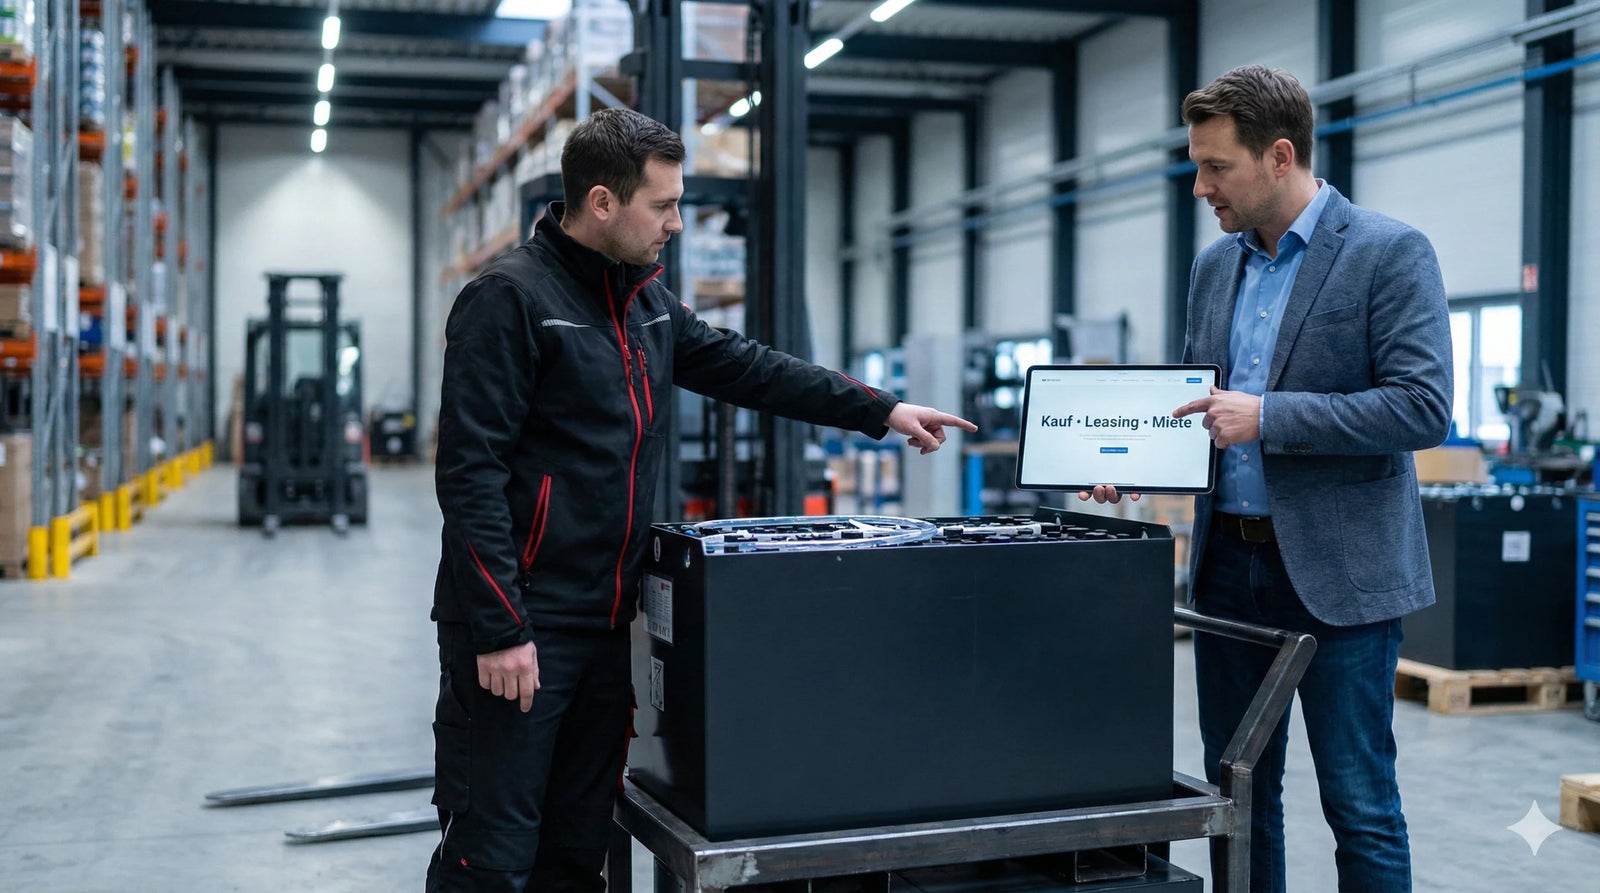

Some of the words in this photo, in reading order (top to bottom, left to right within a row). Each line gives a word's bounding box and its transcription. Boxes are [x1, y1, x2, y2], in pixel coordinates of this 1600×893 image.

[1041, 415, 1073, 427] Kauf
[1085, 416, 1139, 430] Leasing
[1152, 416, 1192, 428] Miete
